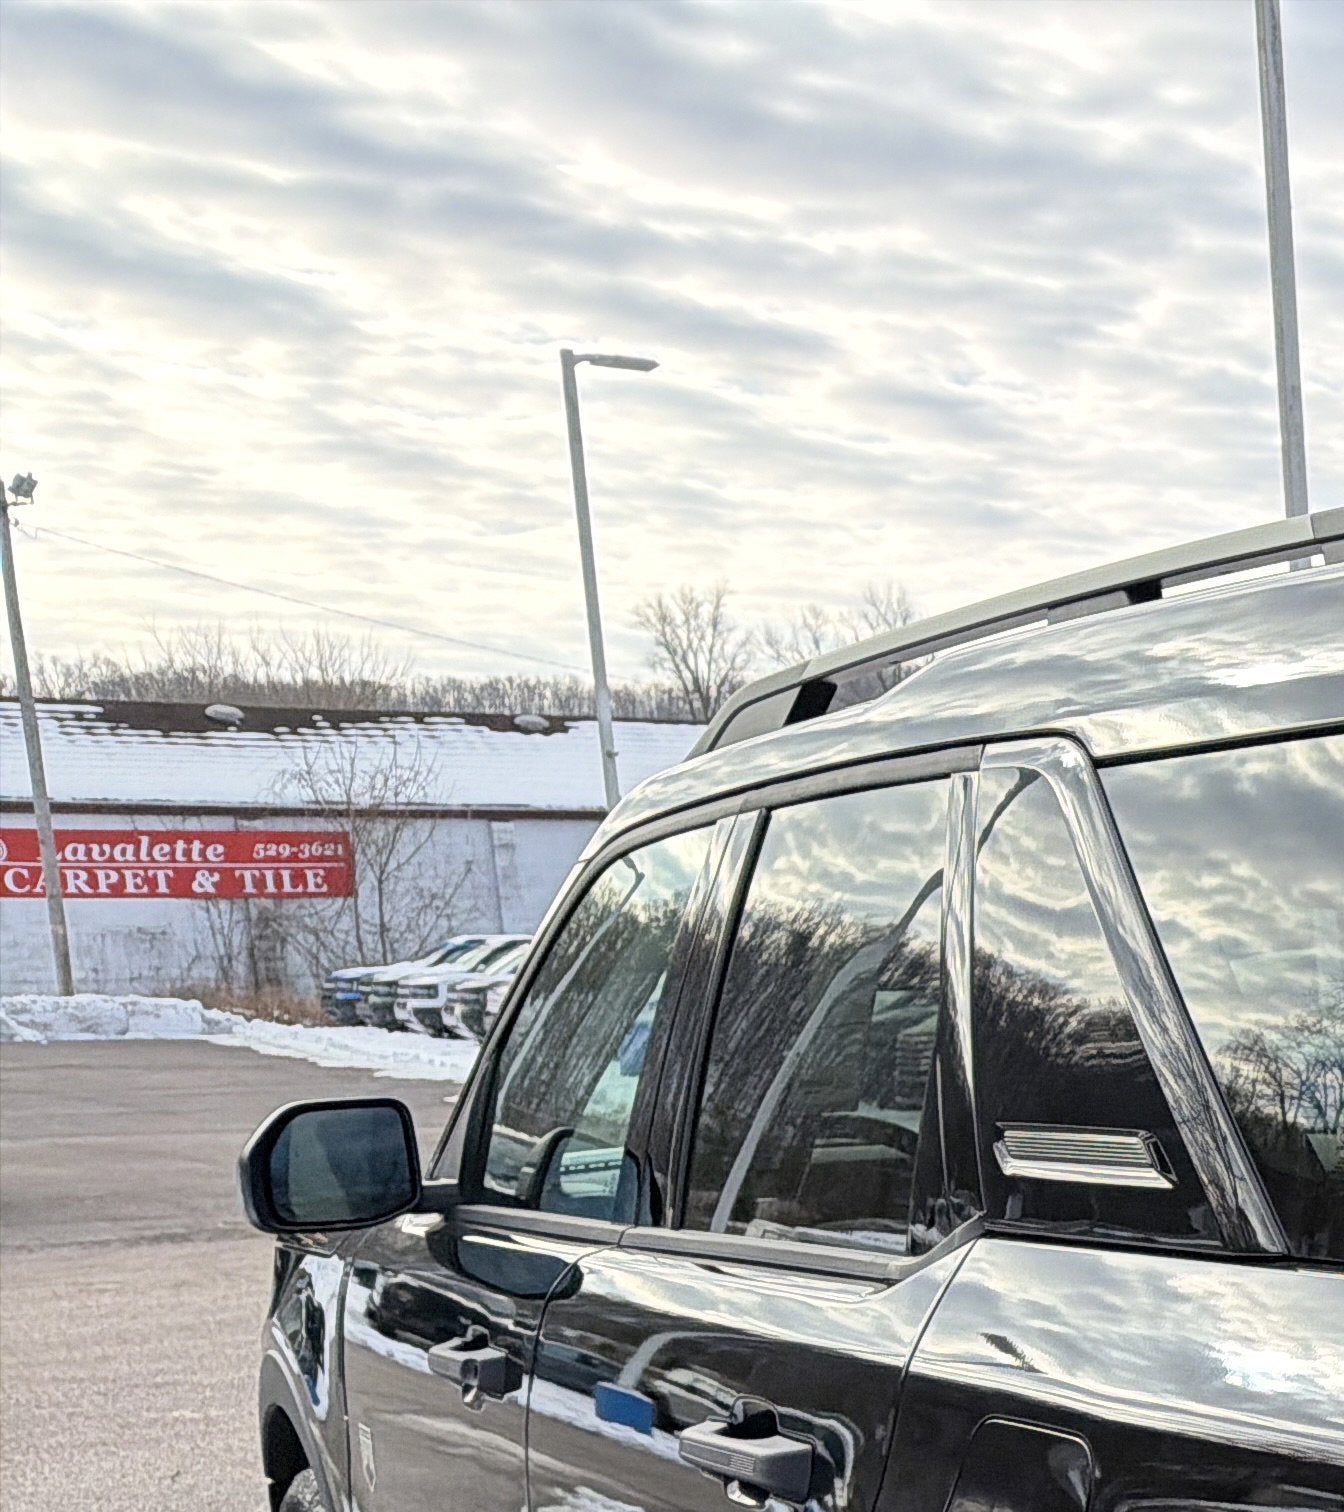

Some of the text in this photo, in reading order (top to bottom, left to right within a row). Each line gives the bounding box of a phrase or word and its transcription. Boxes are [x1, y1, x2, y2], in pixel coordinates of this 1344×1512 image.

[36, 836, 343, 861] avalette 529-3621
[191, 869, 221, 894] &
[235, 869, 328, 894] TILE
